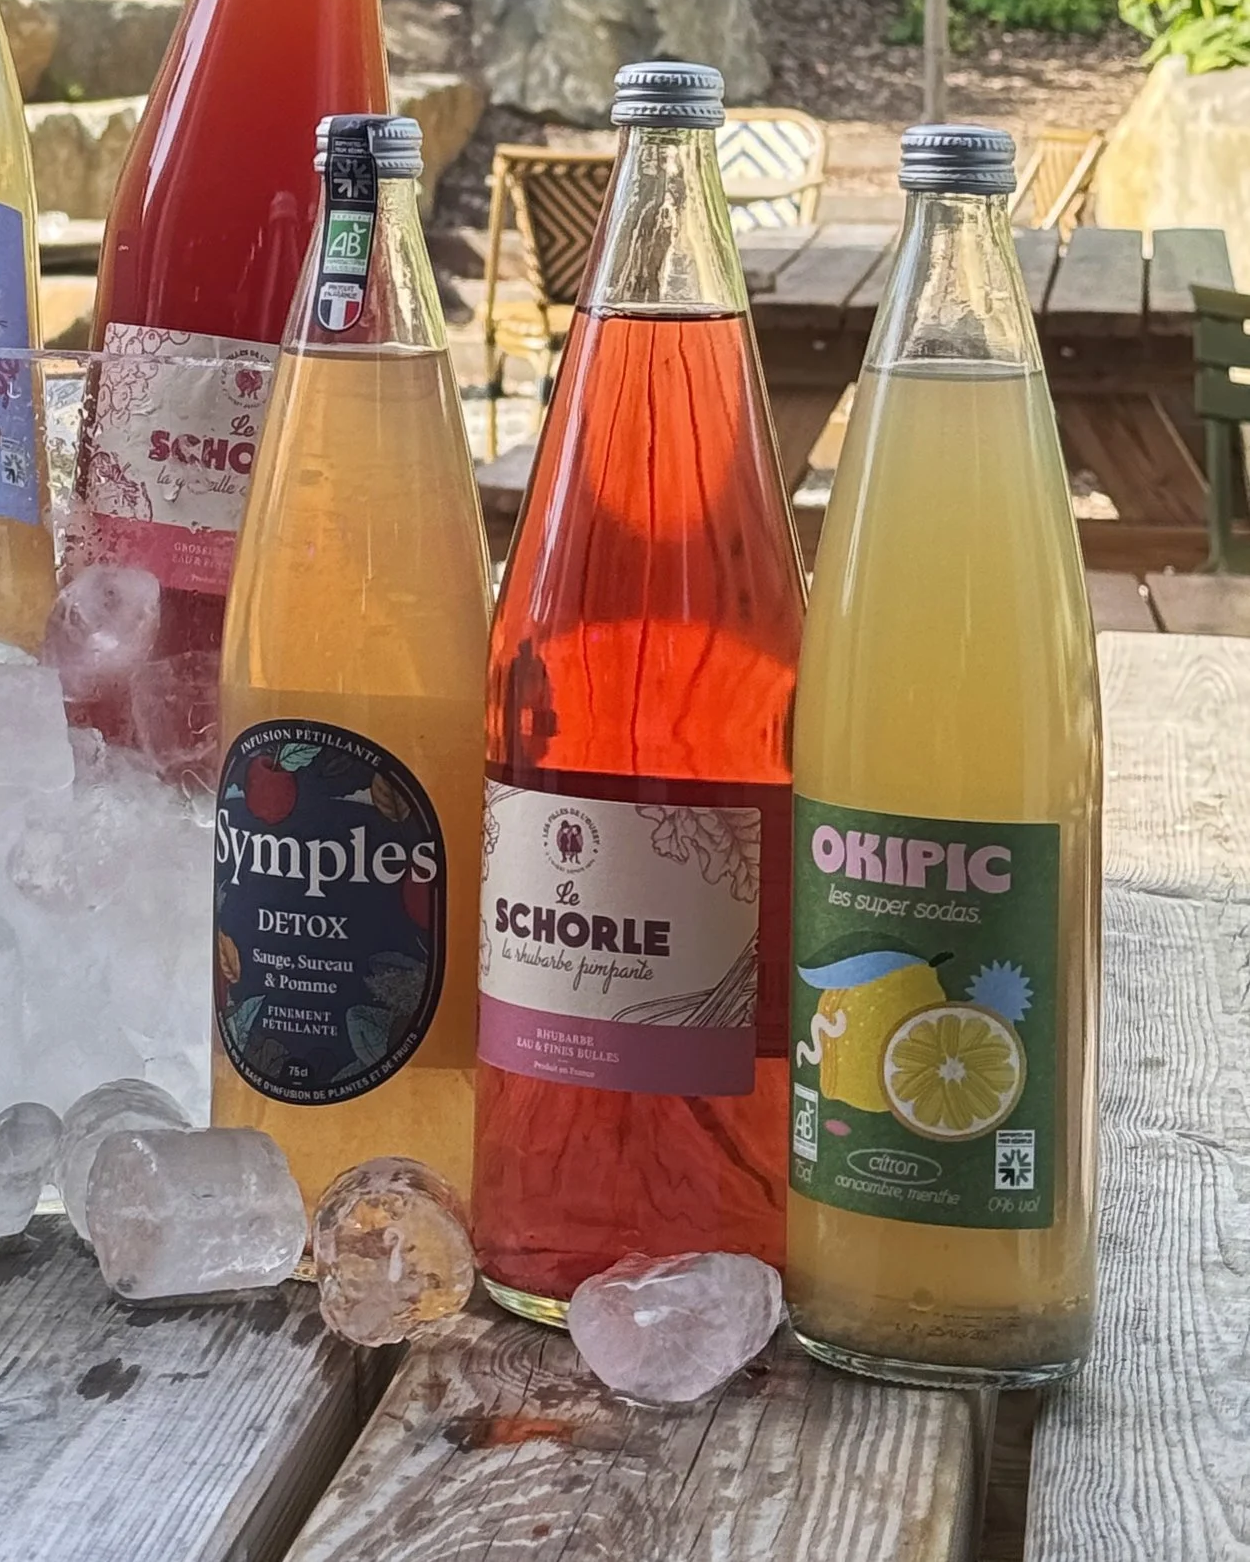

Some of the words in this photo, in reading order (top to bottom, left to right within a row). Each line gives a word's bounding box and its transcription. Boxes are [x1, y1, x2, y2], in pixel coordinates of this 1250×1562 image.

[329, 231, 361, 257] AB
[229, 414, 254, 437] Le
[149, 430, 256, 475] SCHO
[240, 728, 292, 755] INFUSION
[296, 727, 382, 767] PÉTILLANTE
[216, 808, 438, 898] Symples
[811, 824, 1012, 894] OKIPIC
[555, 880, 581, 906] Le
[828, 883, 852, 907] les
[854, 894, 911, 918] super
[913, 901, 982, 924] sodas.
[258, 908, 349, 940] DETOX
[495, 897, 671, 957] SCHORLE
[252, 948, 295, 971] Sauge,
[298, 954, 354, 973] Sureau
[502, 938, 512, 959] la
[516, 942, 573, 972] rhubarbe
[572, 955, 654, 994] pimpante
[264, 972, 276, 988] &
[279, 974, 338, 994] Pomme
[262, 1017, 338, 1037] PÉTILLANTE
[267, 1005, 332, 1023] FINEMENT
[536, 1028, 594, 1047] RHUBARBE
[543, 1042, 574, 1057] FINES
[577, 1048, 619, 1063] BULLES
[263, 1081, 311, 1100] D'INFUSION
[313, 1090, 327, 1100] DE
[328, 1078, 368, 1098] PLANTES
[370, 1070, 381, 1082] ET
[381, 1060, 394, 1074] DE
[288, 1065, 308, 1077] 75cl
[795, 1109, 813, 1139] AB
[868, 1152, 919, 1177] citron
[834, 1173, 903, 1201] concombre,
[906, 1187, 961, 1206] menthe
[987, 1196, 1015, 1213] 0%
[1018, 1196, 1041, 1213] vol
